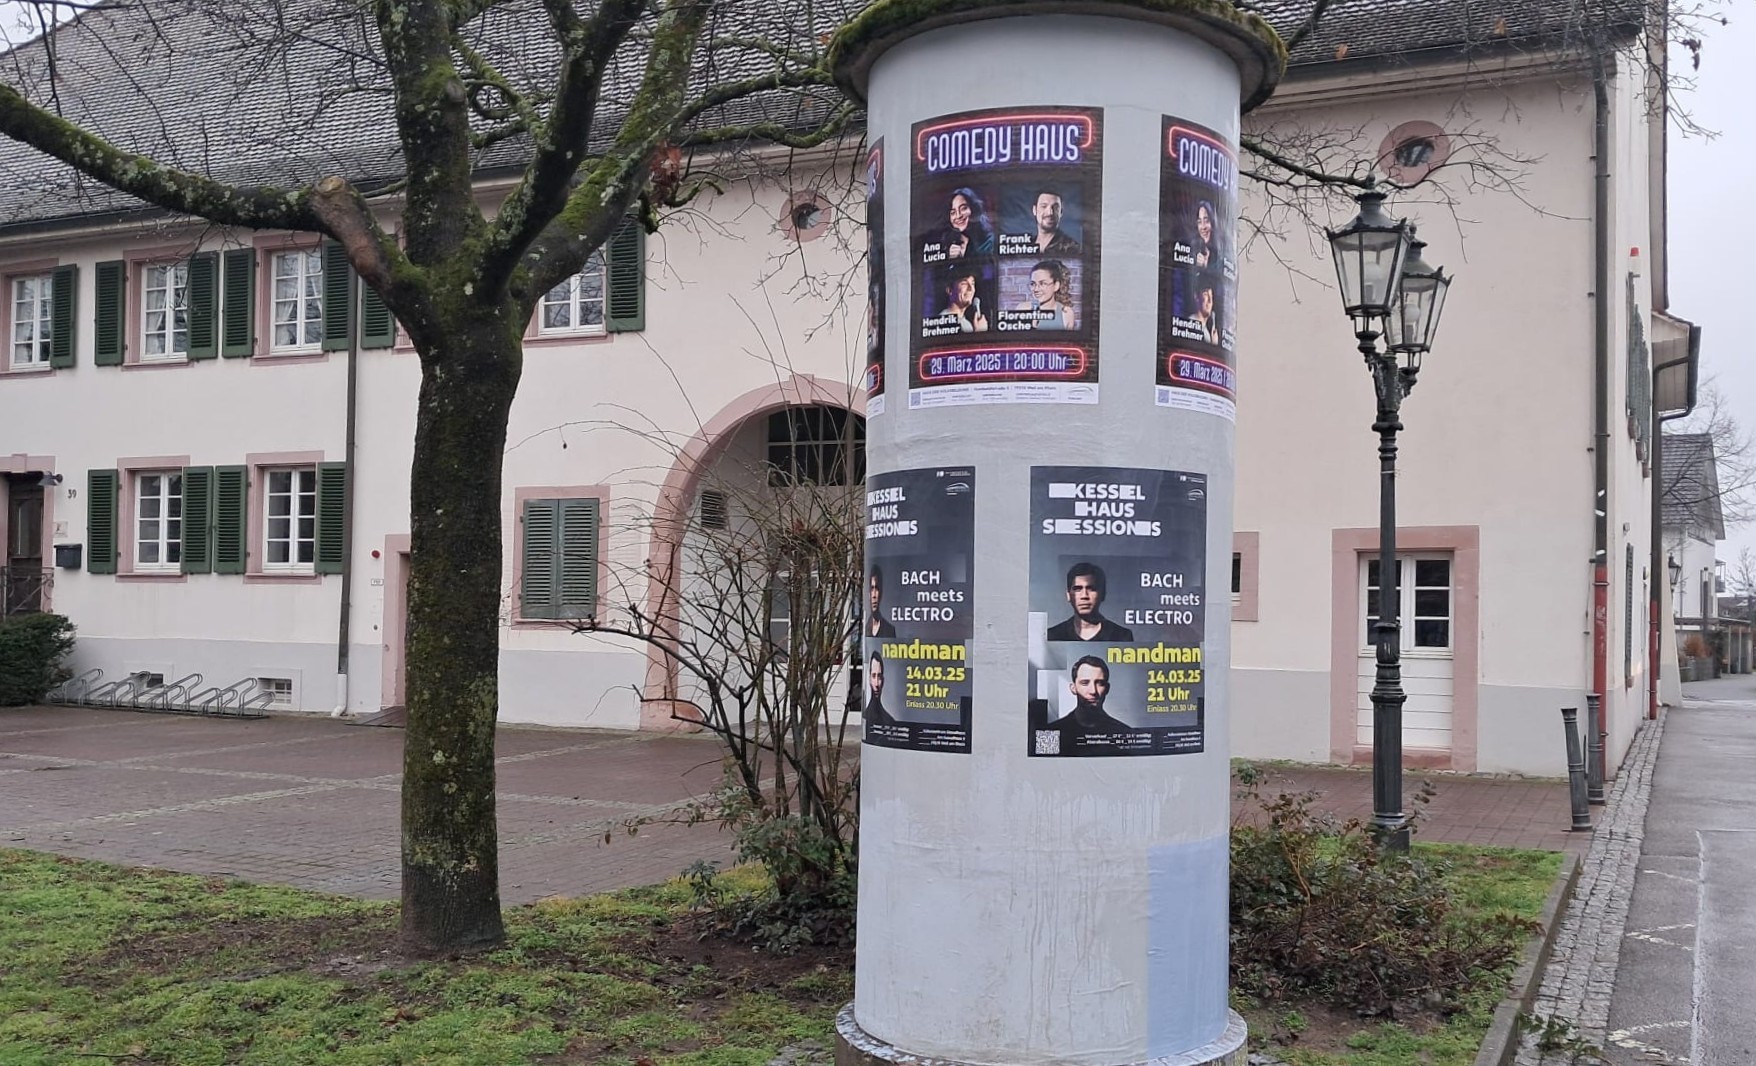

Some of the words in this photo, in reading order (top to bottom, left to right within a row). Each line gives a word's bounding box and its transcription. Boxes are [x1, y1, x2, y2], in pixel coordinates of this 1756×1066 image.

[928, 126, 1011, 171] COMEDY
[1020, 124, 1079, 161] HAUS
[1180, 138, 1229, 190] COMEDY
[999, 234, 1031, 244] Frank
[923, 243, 941, 253] Ana
[999, 244, 1038, 254] Richter
[1174, 242, 1190, 253] Ana
[922, 316, 957, 328] Hendrik
[998, 311, 1054, 321] Florentine
[1172, 316, 1202, 331] Hendrik
[922, 325, 960, 337] Brehmer
[998, 321, 1031, 331] Osche
[1172, 326, 1204, 341] Brehmer
[931, 358, 945, 375] 29.
[947, 355, 972, 373] März
[975, 353, 1001, 371] 2025
[1013, 352, 1044, 370] 20:00
[1048, 353, 1067, 370] Uhr
[68, 489, 77, 499] 39
[1049, 483, 1145, 500] KESSEL
[872, 505, 898, 521] HAUS
[1075, 501, 1135, 517] HAUS
[1042, 519, 1161, 537] SESSIONS
[901, 570, 940, 585] BACH
[1140, 573, 1183, 588] BACH
[917, 589, 964, 602] meets
[1160, 593, 1200, 606] meets
[891, 607, 954, 621] ELECTRO
[1125, 610, 1193, 625] ELECTRO
[882, 639, 966, 660] nandman
[1107, 642, 1201, 663] nandman
[906, 666, 965, 681] 14.03.25
[1147, 670, 1201, 683] 14.03.25
[906, 683, 921, 697] 21
[924, 684, 949, 698] Uhr
[1147, 688, 1165, 701] 21
[1167, 687, 1190, 701] Uhr
[926, 701, 944, 709] 20.30
[945, 701, 959, 709] Uhr
